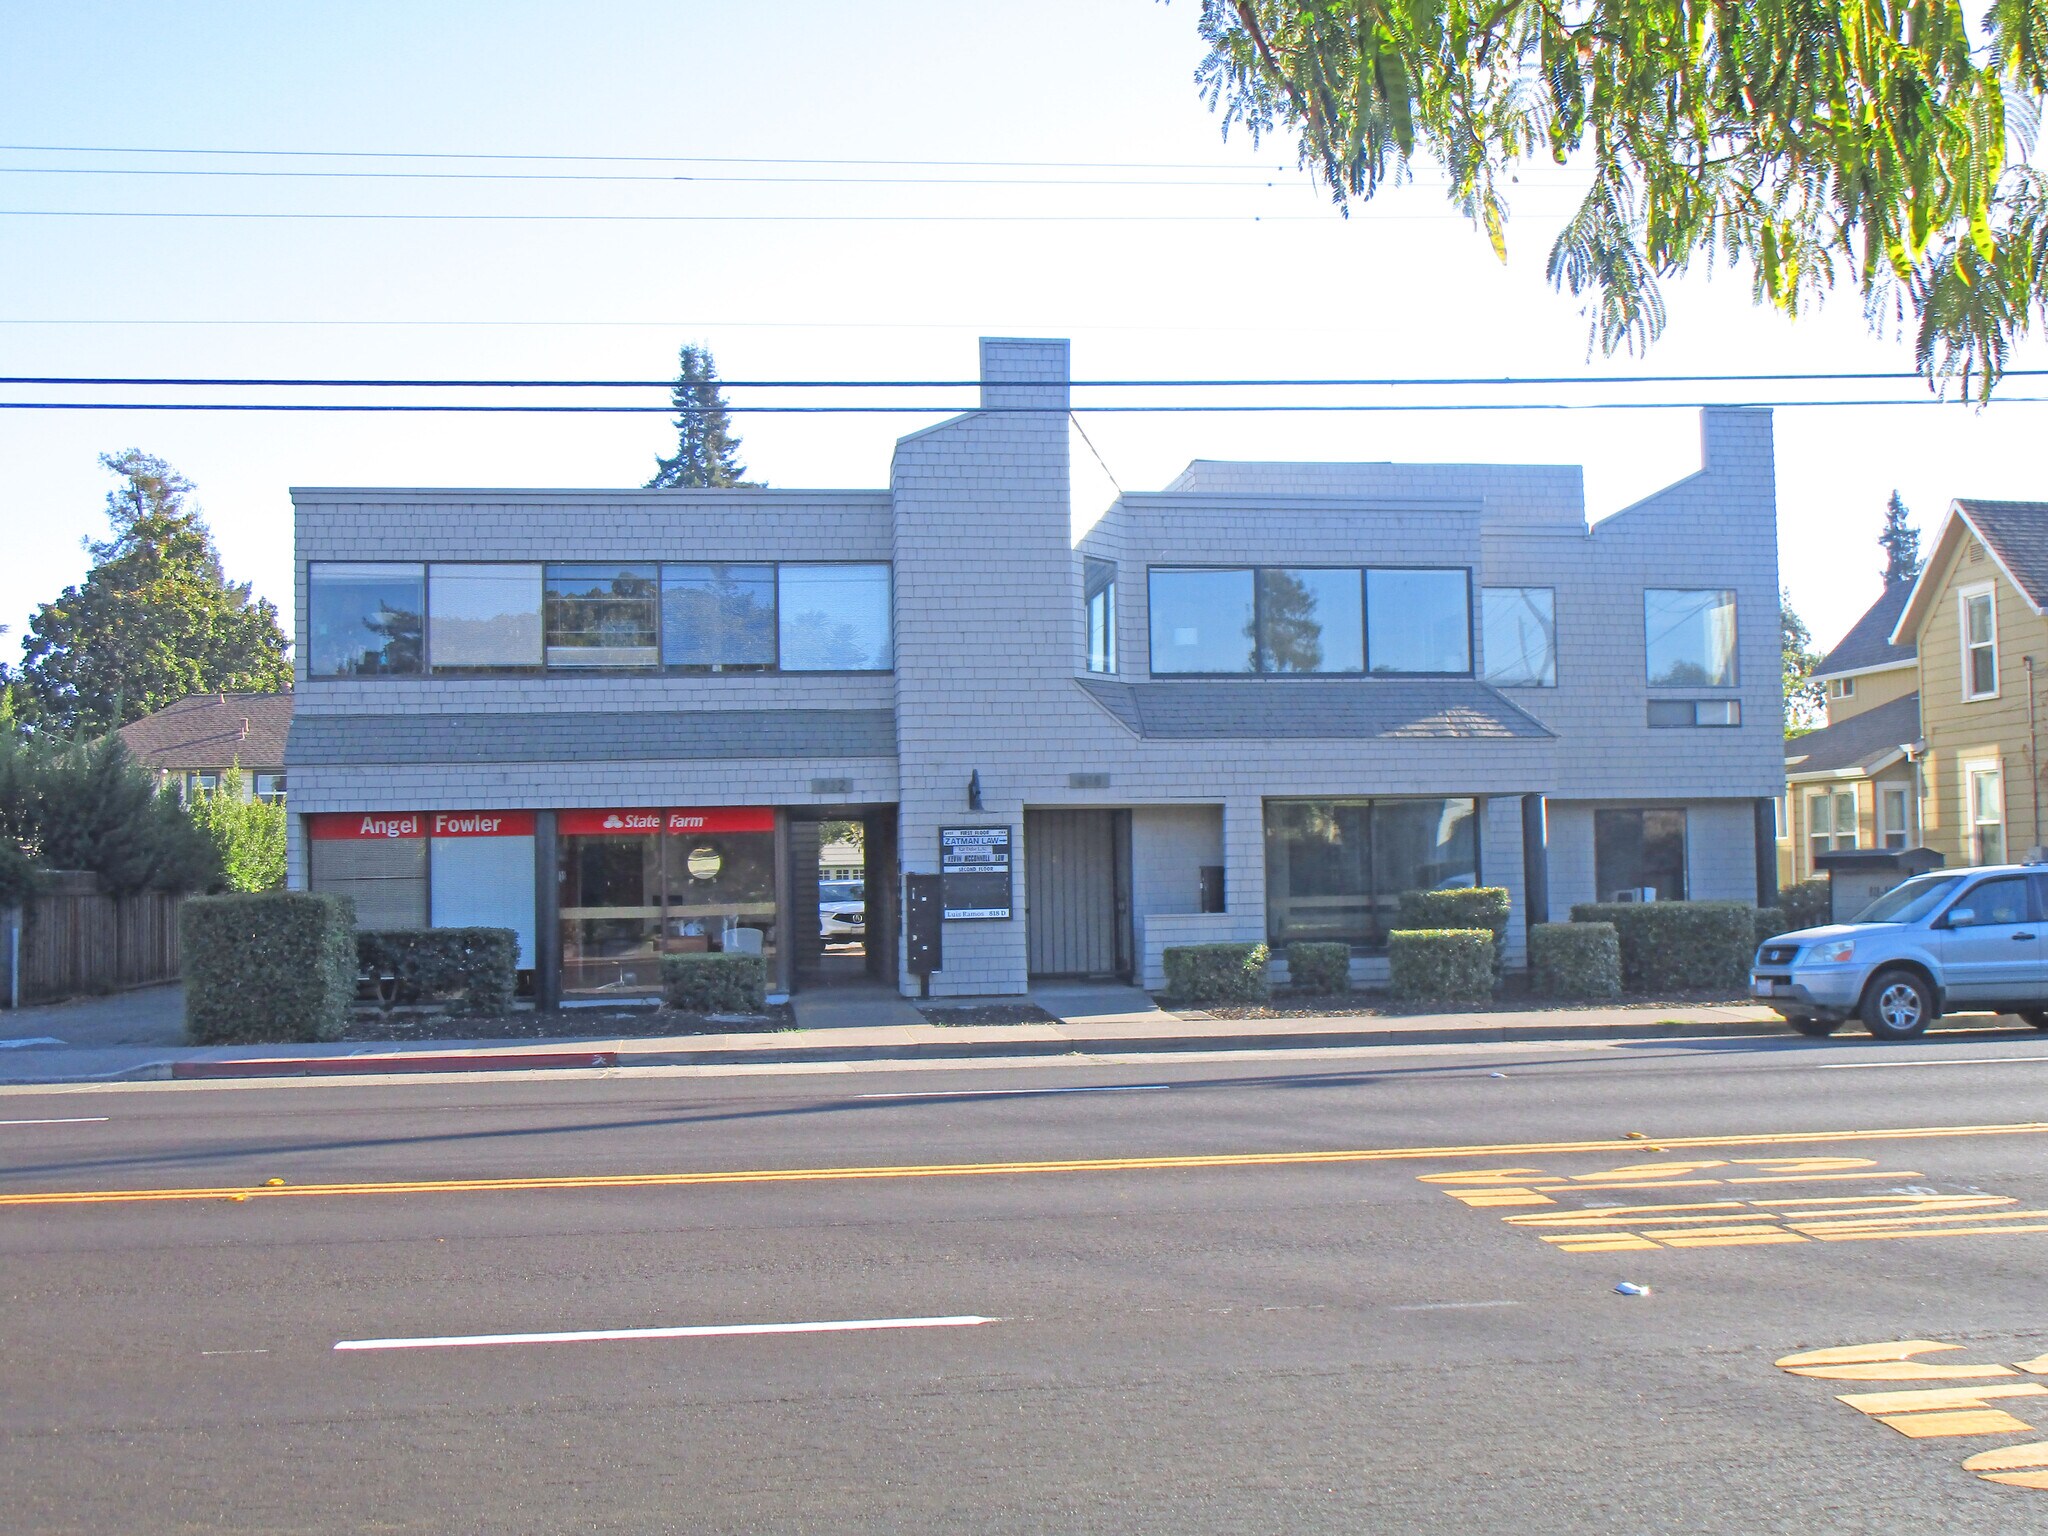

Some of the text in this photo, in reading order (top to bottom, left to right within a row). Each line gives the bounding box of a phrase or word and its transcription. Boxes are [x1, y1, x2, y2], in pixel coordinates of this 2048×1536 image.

[360, 815, 502, 837] Angel Fowler
[624, 814, 704, 828] State Farm
[945, 837, 999, 845] ZATMAN LAW
[947, 855, 962, 863] KEVIN
[995, 854, 1005, 862] LAW
